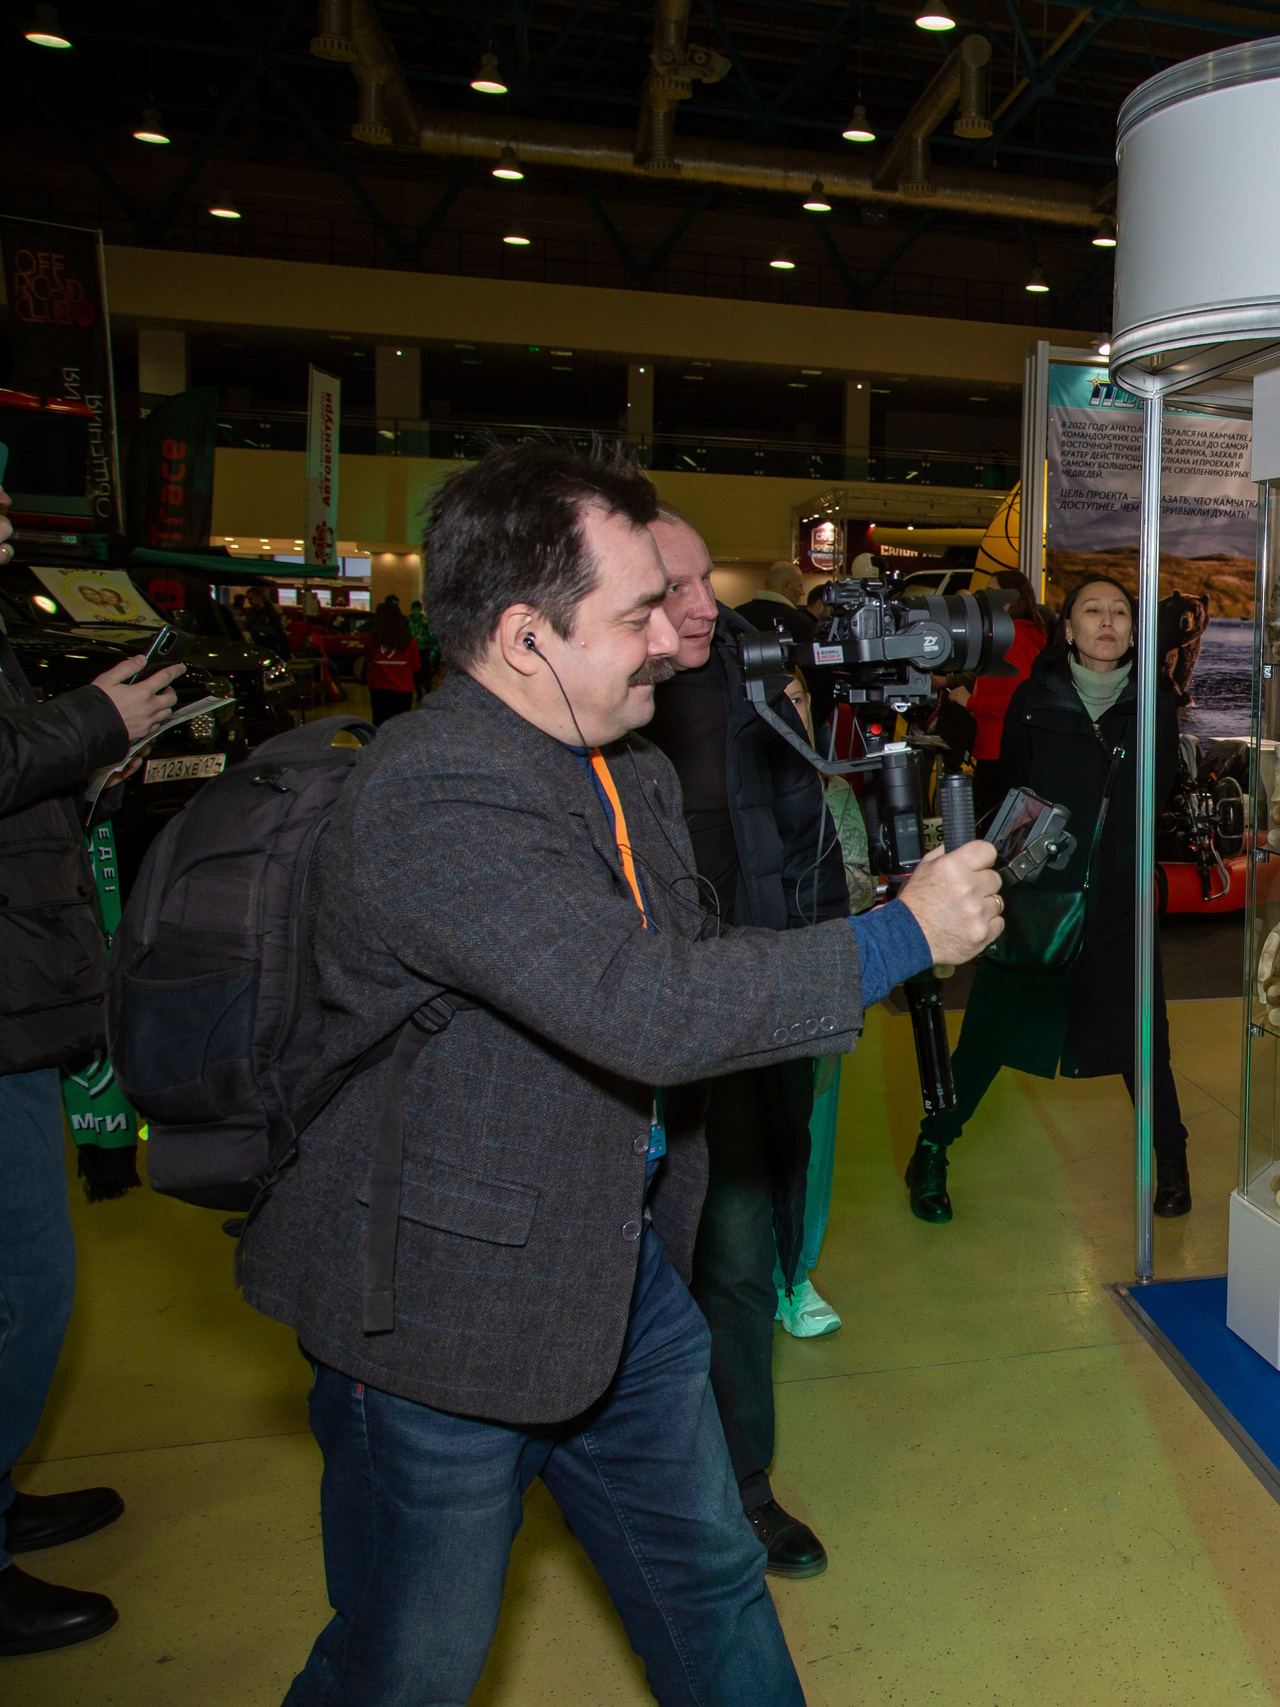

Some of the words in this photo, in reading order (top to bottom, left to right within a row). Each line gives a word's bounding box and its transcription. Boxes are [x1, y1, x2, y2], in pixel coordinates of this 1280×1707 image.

[1061, 431, 1129, 443] КОМАНДОРСКИХ
[1175, 438, 1206, 448] ДОЕХАЛ
[1206, 440, 1219, 450] ДО
[1220, 441, 1249, 451] САМОЙ
[1068, 421, 1086, 430] 2022
[1088, 422, 1109, 432] ГОДУ
[1161, 428, 1196, 437] ОБРАЛСЯ
[1197, 431, 1208, 439] НА
[1208, 431, 1248, 442] КАМЧАТКЕ
[1061, 440, 1112, 450] ВОСТОЧНОЙ
[1113, 444, 1141, 452] ТОЧКИ
[1174, 447, 1208, 459] АФРИКА,
[1209, 450, 1237, 459] ЗАЕХАЛ
[1061, 450, 1089, 459] КРАТЕР
[1161, 456, 1191, 466] УЛКАНА
[1199, 459, 1234, 468] ПРОЕХАЛ
[1060, 469, 1104, 479] МЕДВЕДЕЙ.
[1061, 460, 1097, 470] САМОМУ
[1173, 467, 1224, 477] СКОПЛЕНИЮ
[1224, 470, 1250, 479] БУРЫХ
[1060, 488, 1084, 499] ЦЕЛЬ
[1085, 490, 1128, 501] ПРОЕКТА
[1193, 497, 1212, 506] ЧТО
[1059, 500, 1118, 513] ДОСТУПНЕЕ,
[1119, 504, 1140, 513] ЧЕМ
[1210, 508, 1250, 519] ДУМАТЬ!
